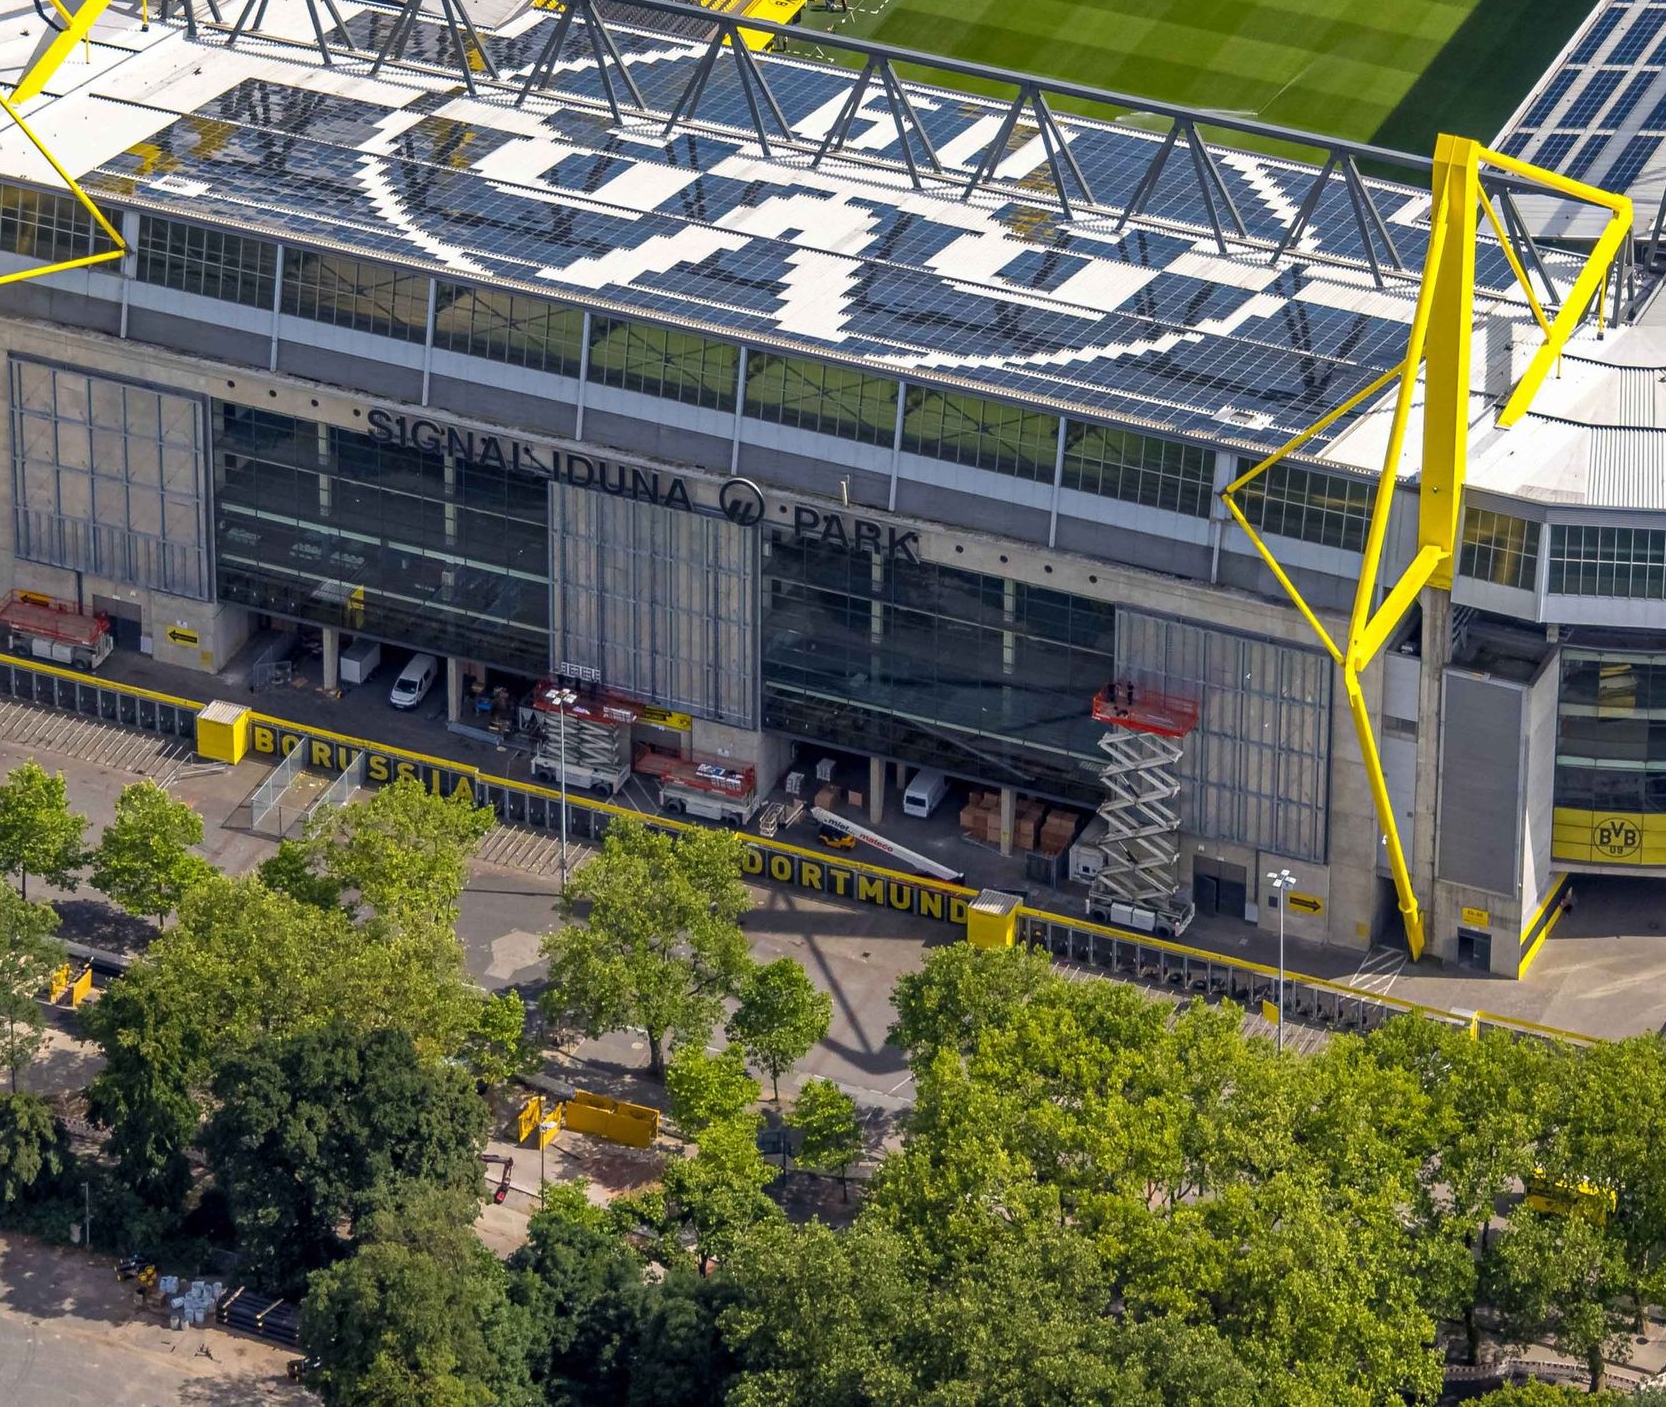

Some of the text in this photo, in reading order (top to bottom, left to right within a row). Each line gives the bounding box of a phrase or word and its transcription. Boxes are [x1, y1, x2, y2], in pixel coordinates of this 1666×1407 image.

[366, 408, 921, 566] SIGNAL IDUNA PARK
[253, 726, 475, 801] BORUSSIA
[859, 833, 894, 853] mateco
[1599, 820, 1637, 846] BVB
[742, 848, 969, 924] DORTMUND
